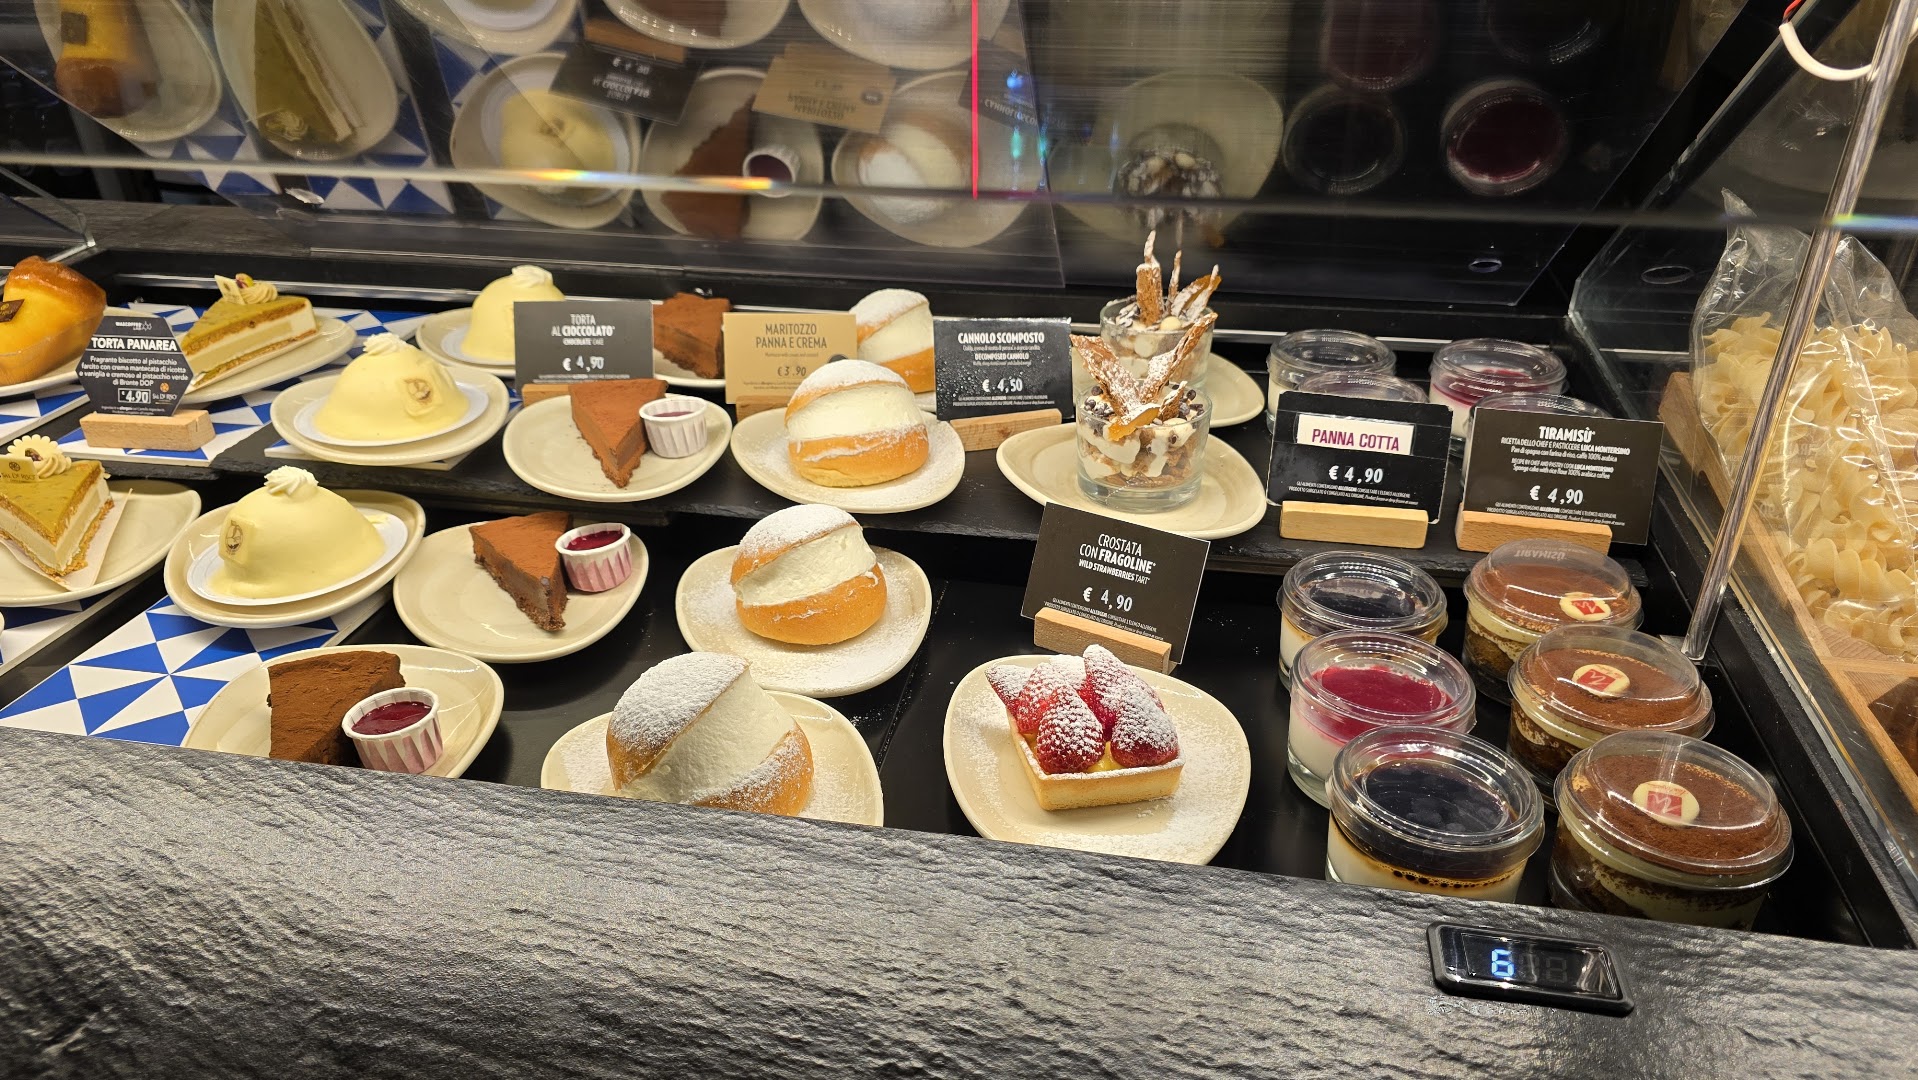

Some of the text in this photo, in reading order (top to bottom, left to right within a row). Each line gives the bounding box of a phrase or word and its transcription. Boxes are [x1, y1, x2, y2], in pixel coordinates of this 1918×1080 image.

[570, 314, 596, 325] TORTA
[551, 326, 562, 336] AL
[765, 324, 817, 335] MARITOZZO
[91, 337, 178, 351] TORTA PANAREA
[756, 337, 827, 348] PANNA E CREMA
[958, 332, 1044, 344] CANNOLO SCOMPOSTO
[82, 362, 99, 370] farcito
[90, 355, 117, 364] Fragrante
[149, 358, 177, 366] pistacchio
[562, 355, 604, 372] € 4,90
[982, 378, 1023, 393] € 4,50
[1312, 429, 1399, 451] PANNA COTTA
[1501, 437, 1520, 445] RICETTA
[1553, 442, 1580, 450] PASTICCERE
[1581, 444, 1594, 452] LUCA
[1595, 446, 1630, 455] MONTERSINO
[1329, 465, 1384, 484] € 4,90
[1530, 486, 1583, 505] € 4,90
[1080, 544, 1098, 559] CON
[1098, 534, 1142, 556] CROSTATA
[1079, 559, 1093, 570] WILD
[1093, 562, 1135, 581] STRAWBERRIES
[1083, 587, 1133, 612] € 4,90
[1491, 949, 1514, 978] 6
